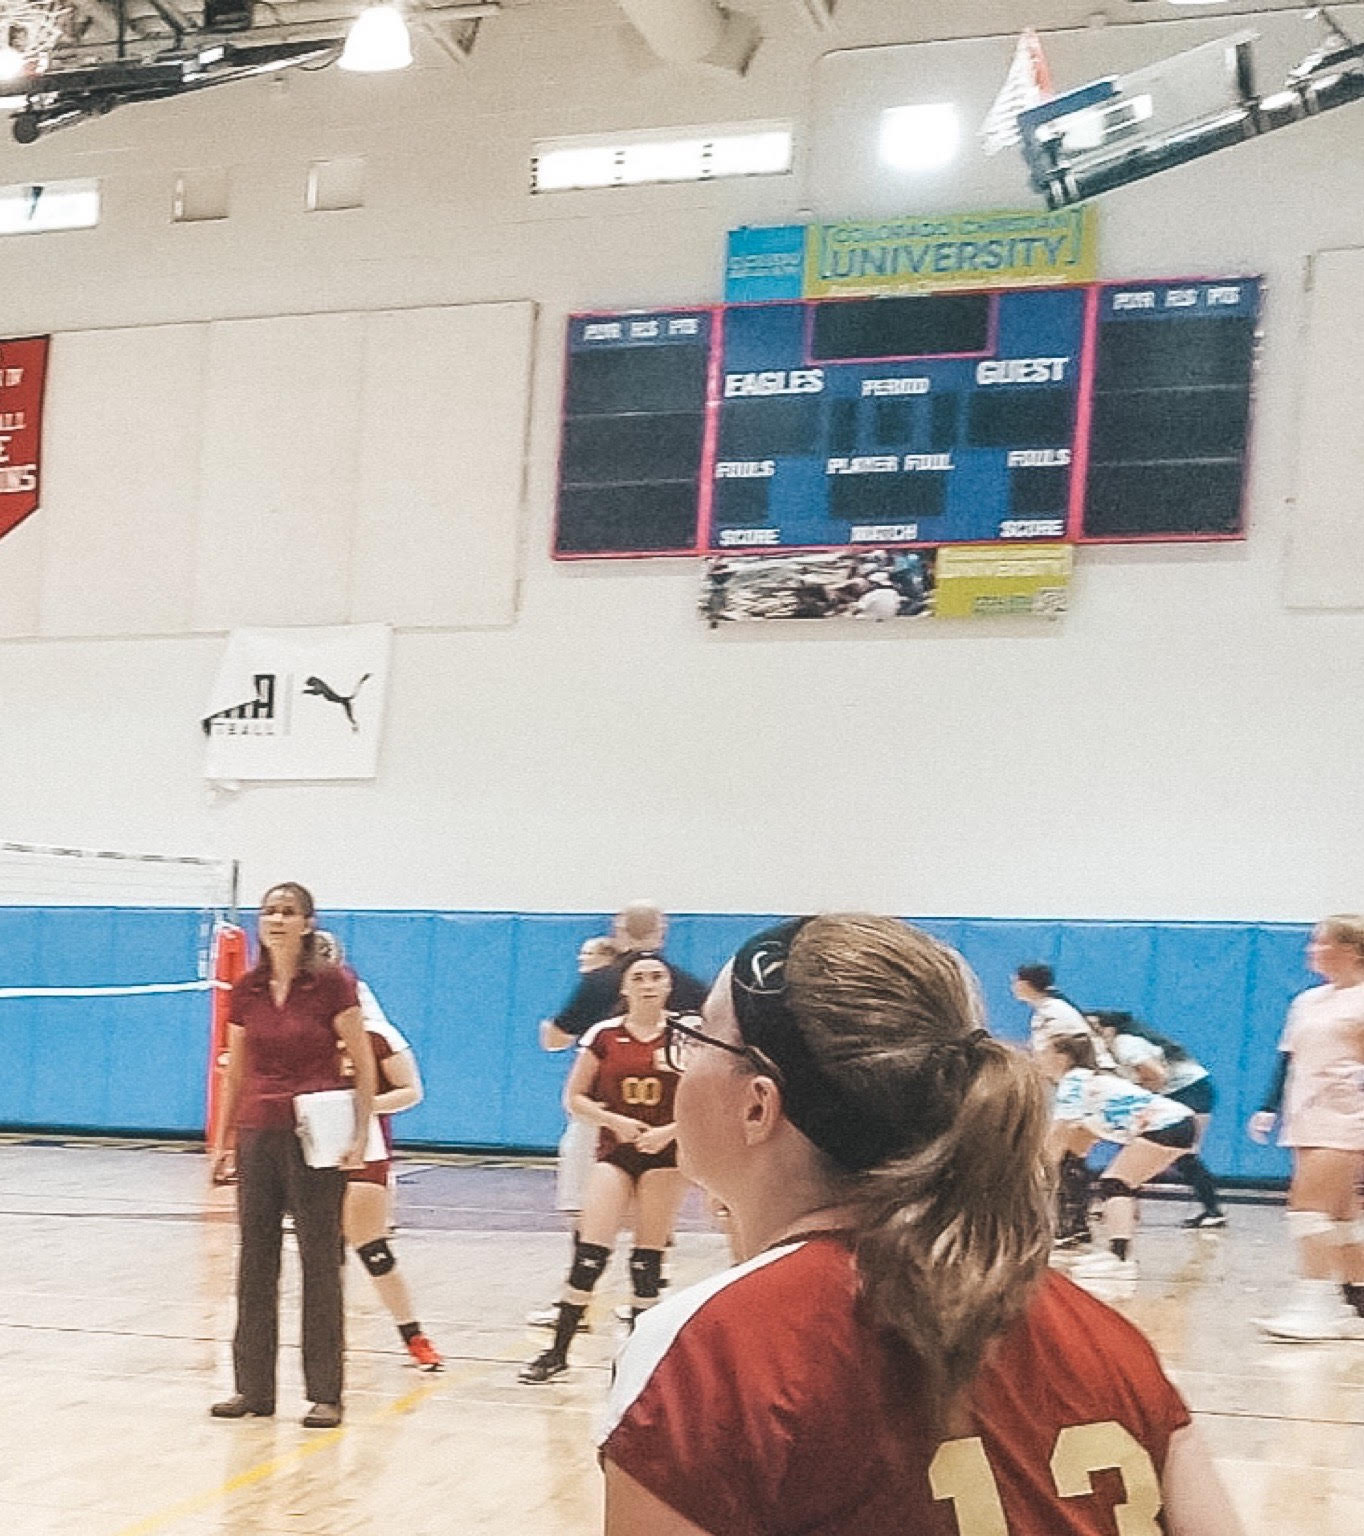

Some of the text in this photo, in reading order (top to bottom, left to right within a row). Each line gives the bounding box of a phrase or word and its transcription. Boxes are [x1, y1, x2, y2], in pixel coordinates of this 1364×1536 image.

[830, 235, 1068, 278] UNIVERSITY
[724, 368, 825, 399] EAGLES
[976, 356, 1070, 386] GUEST
[716, 459, 776, 479] FOULS
[826, 455, 899, 475] PLAYER
[1007, 448, 1071, 468] FOULS
[621, 1076, 662, 1106] 00
